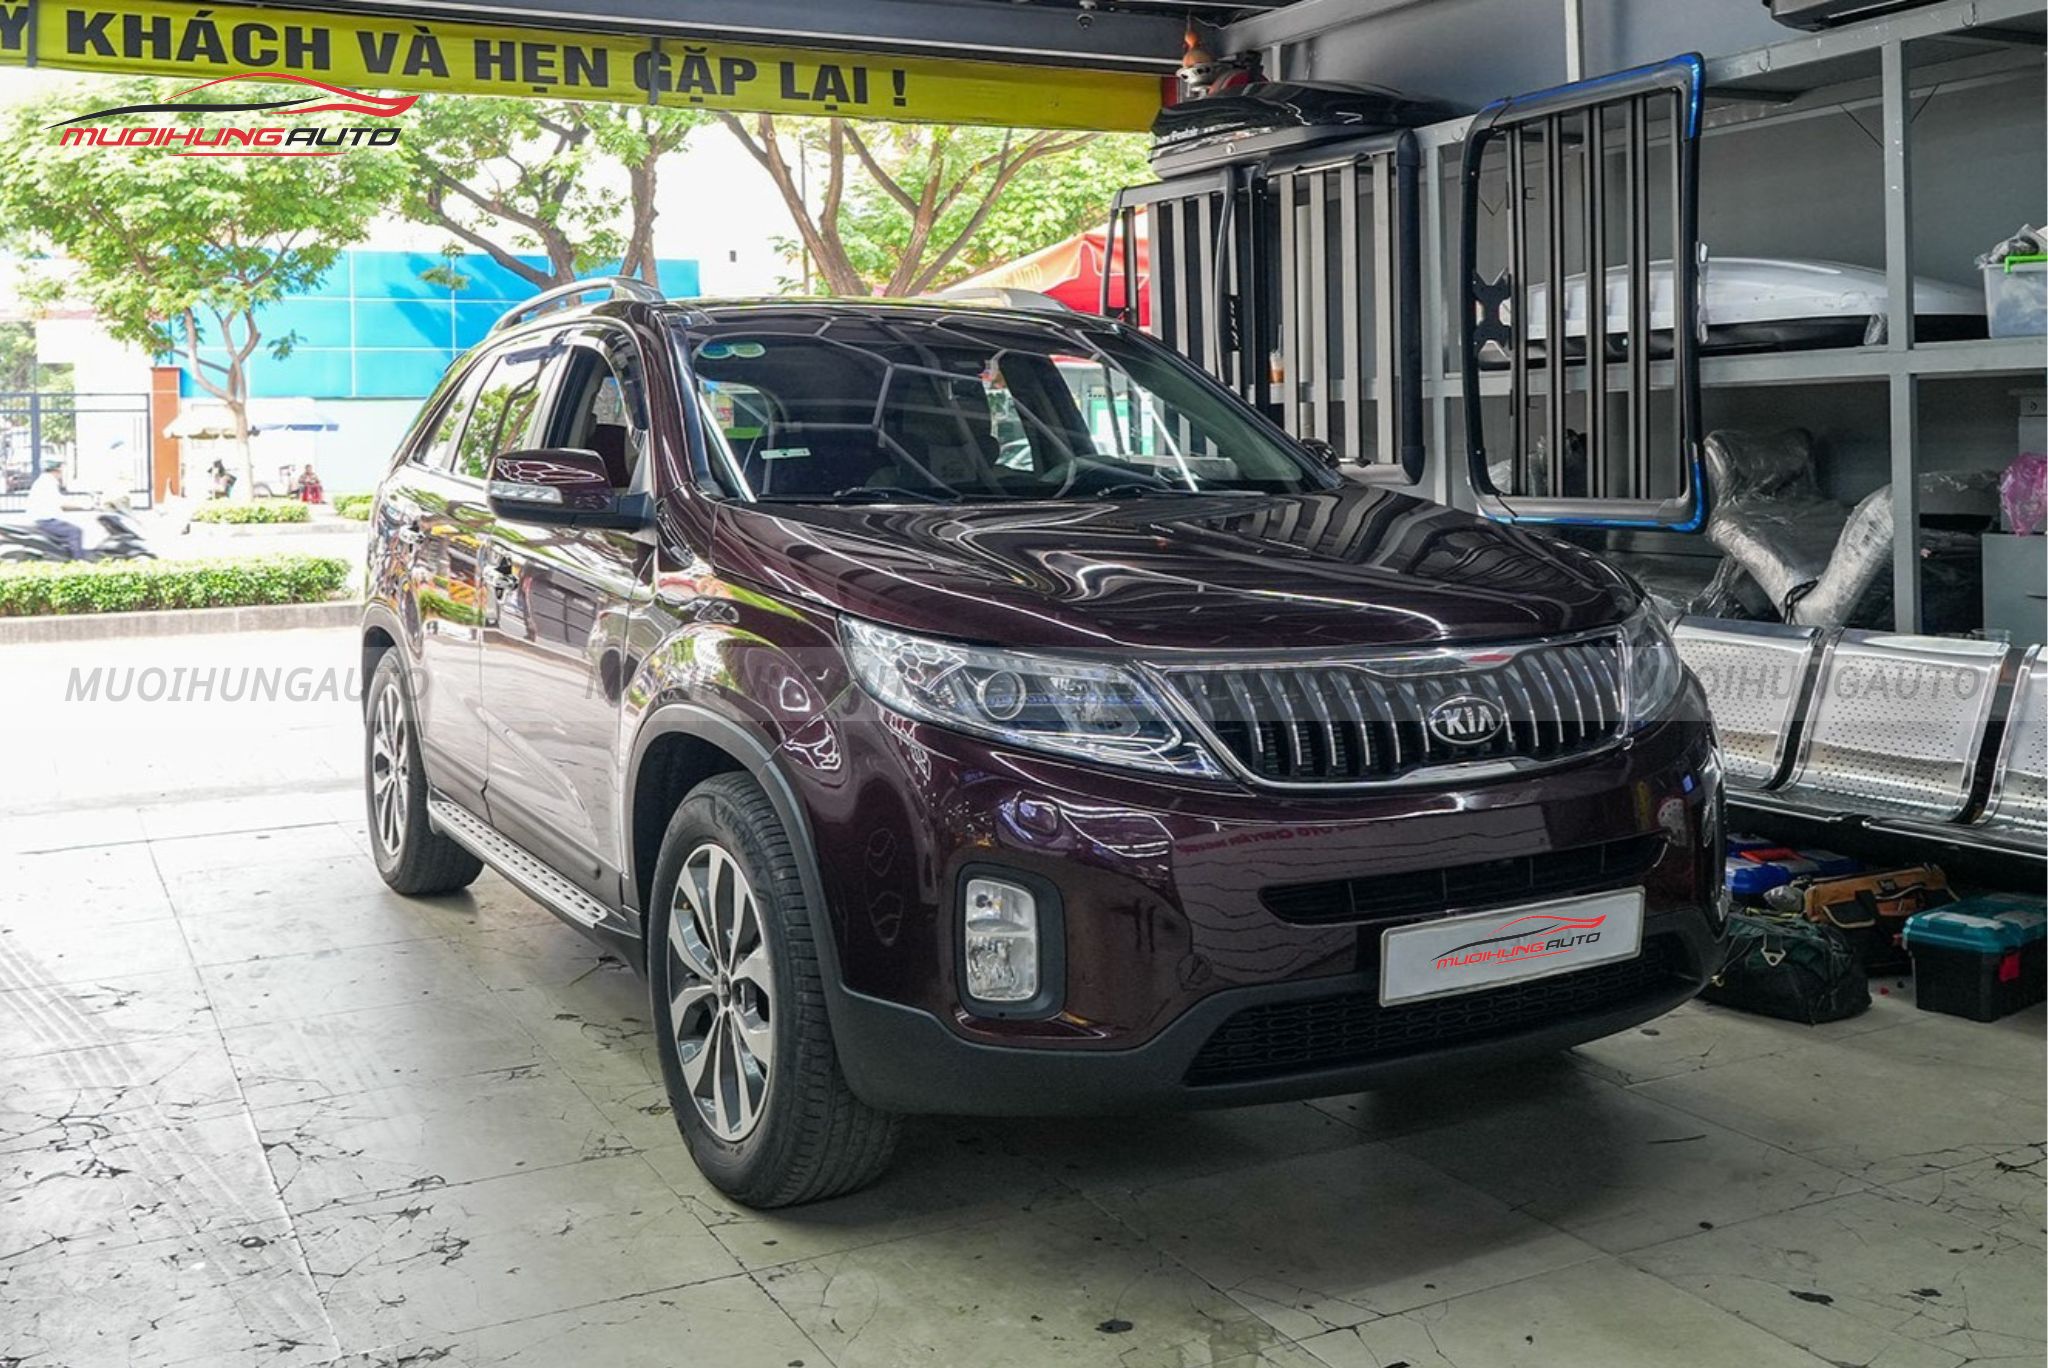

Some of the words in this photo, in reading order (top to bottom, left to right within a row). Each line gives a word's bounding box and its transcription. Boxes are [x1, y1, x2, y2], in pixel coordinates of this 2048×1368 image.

[66, 10, 331, 71] KHÁCH
[356, 25, 450, 78] VÀ
[474, 39, 609, 93] HẸN
[633, 46, 757, 103] GẶP
[780, 62, 869, 112] LẠI
[892, 69, 907, 107] !
[1442, 704, 1496, 736] KIA
